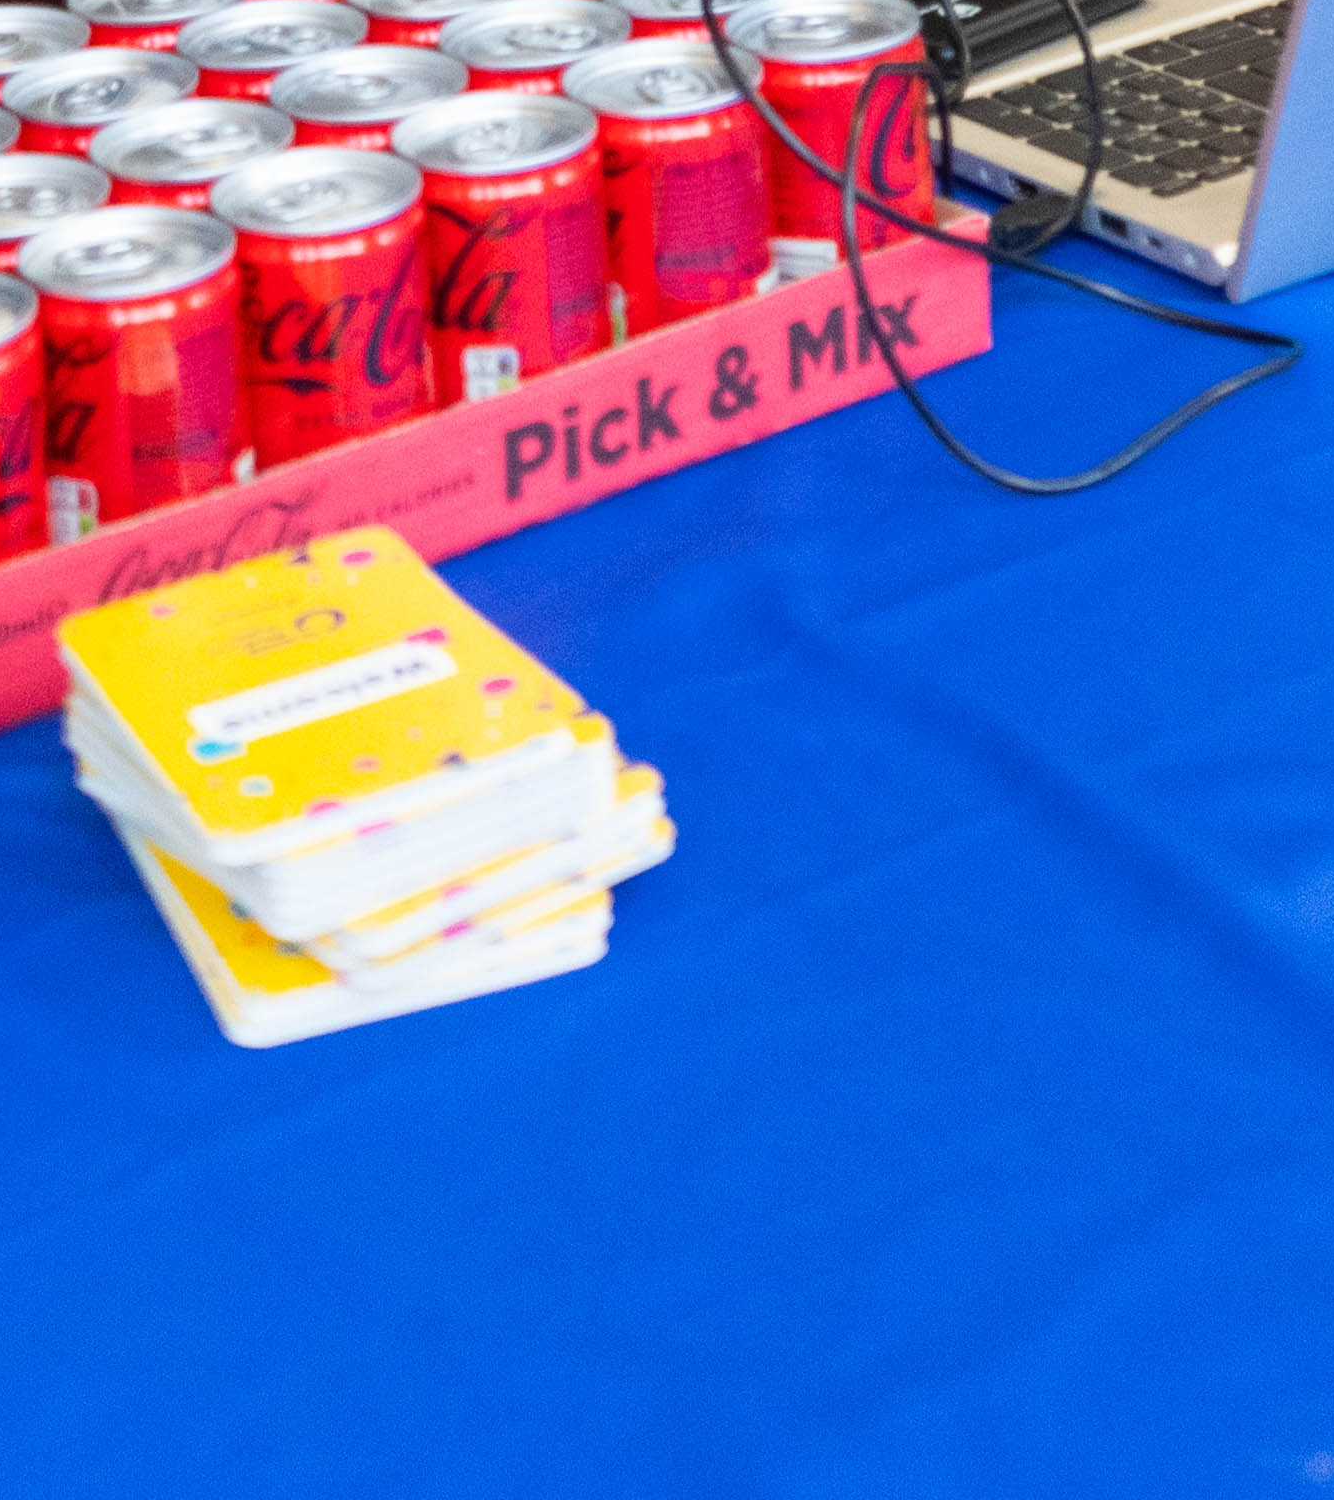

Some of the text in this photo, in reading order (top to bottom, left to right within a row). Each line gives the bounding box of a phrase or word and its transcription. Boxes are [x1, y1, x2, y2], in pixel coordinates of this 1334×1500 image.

[504, 295, 919, 500] Pick & Mix
